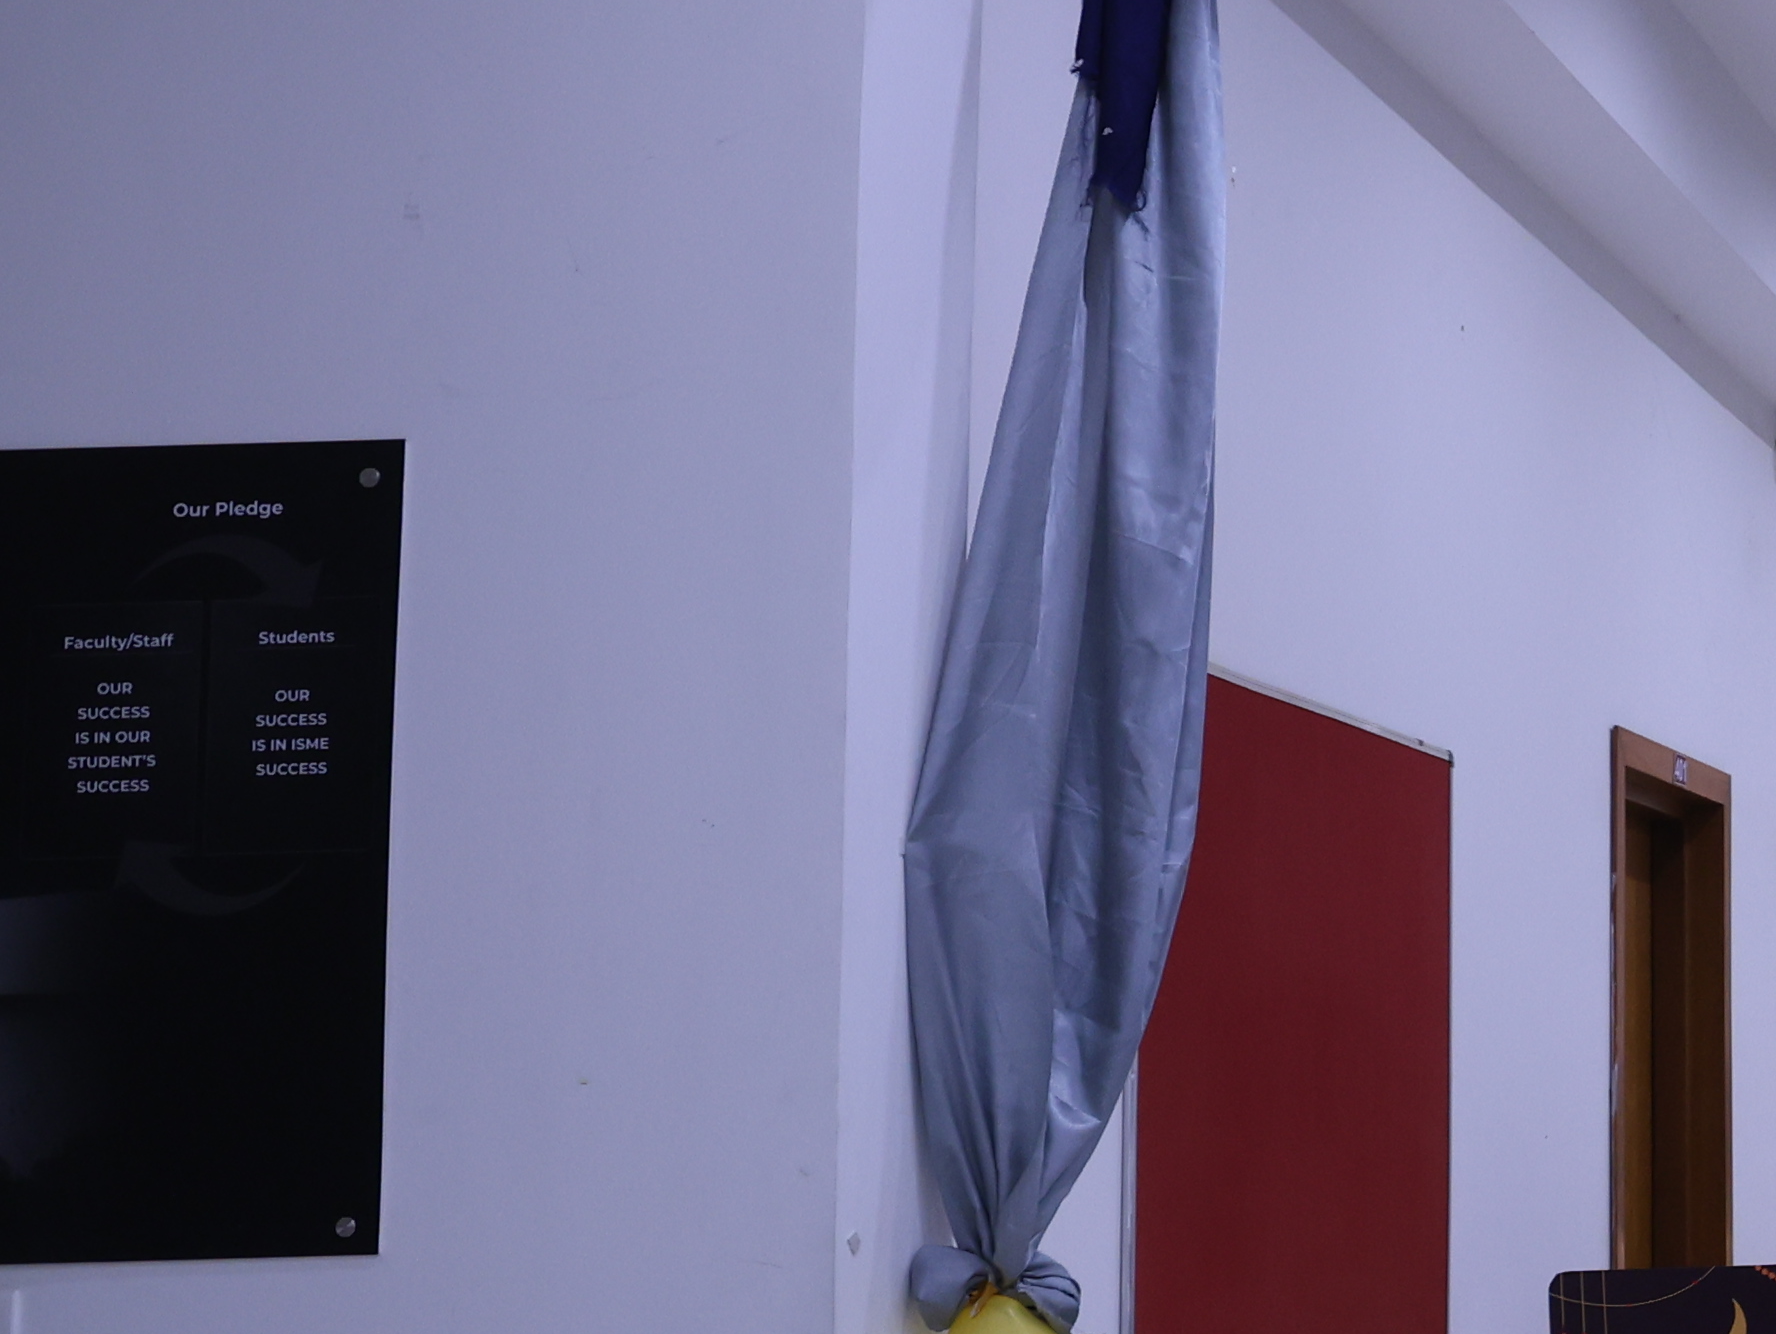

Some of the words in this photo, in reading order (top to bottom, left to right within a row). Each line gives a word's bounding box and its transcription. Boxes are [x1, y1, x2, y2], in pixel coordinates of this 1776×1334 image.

[173, 502, 210, 519] Our
[215, 500, 284, 519] Pledge
[64, 633, 174, 651] Faculty/Staff
[258, 630, 335, 645] Students
[97, 682, 133, 695] OUR
[274, 689, 310, 702] OUR
[77, 706, 150, 720] SUCCESS
[255, 712, 327, 727] SUCCESS
[75, 731, 90, 744] IS
[94, 731, 111, 744] IN
[115, 730, 151, 743] OUR
[252, 739, 266, 752] IS
[270, 739, 287, 752] IN
[291, 737, 329, 751] ISME
[67, 754, 156, 769] STUDENT'S
[256, 761, 328, 776] SUCCESS
[77, 779, 150, 793] SUCCESS
